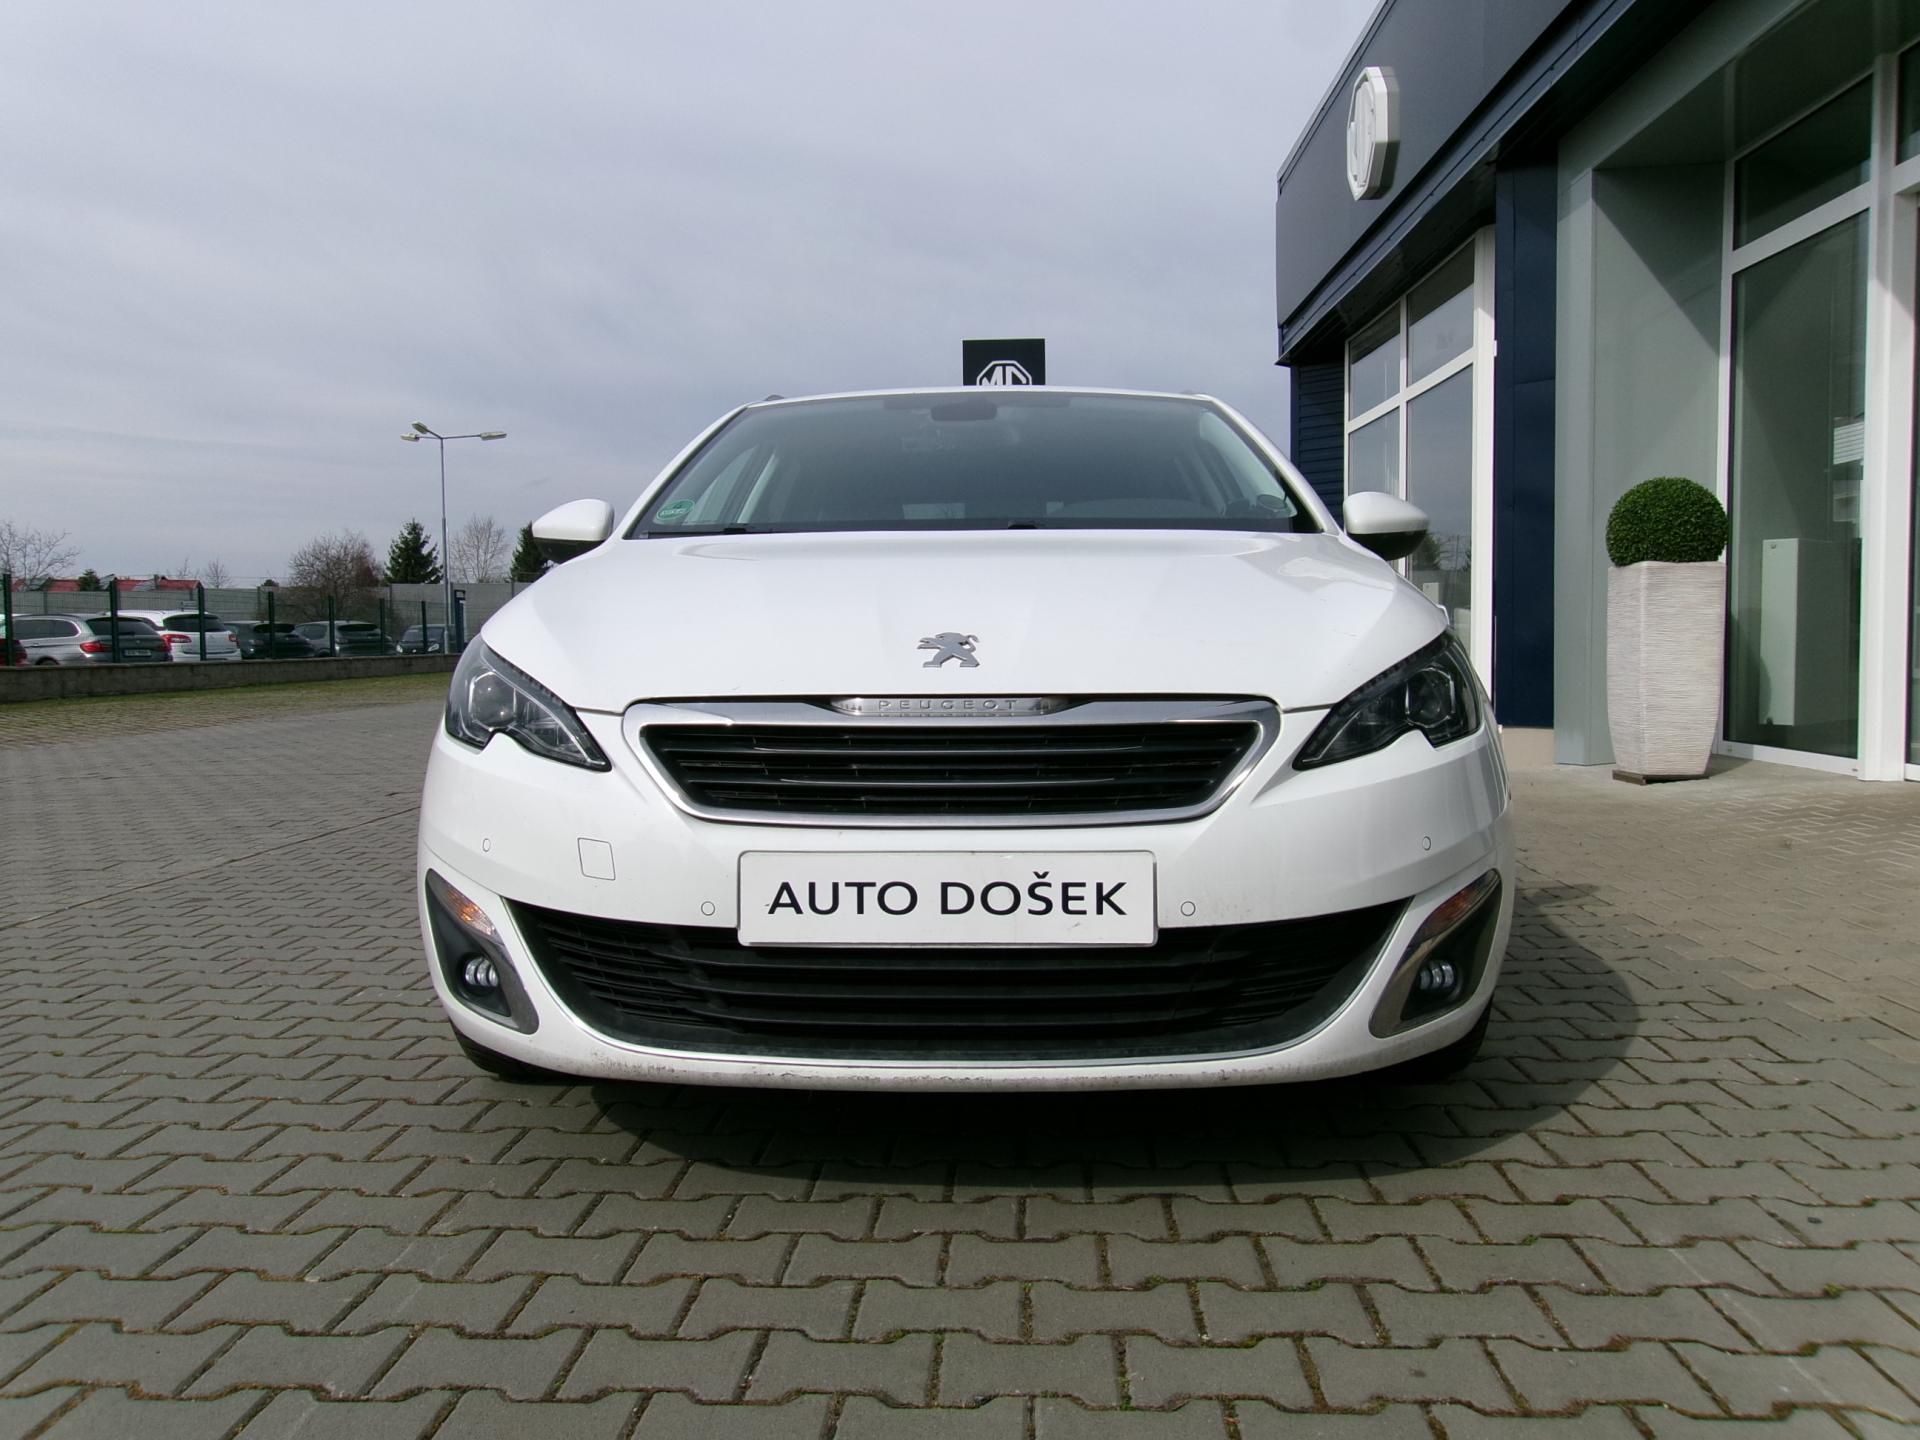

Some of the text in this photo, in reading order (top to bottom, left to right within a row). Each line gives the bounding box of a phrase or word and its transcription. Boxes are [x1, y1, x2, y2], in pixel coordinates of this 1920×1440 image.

[878, 699, 1018, 711] PEUGEOT
[768, 871, 1128, 916] AUTO DOŠEK
